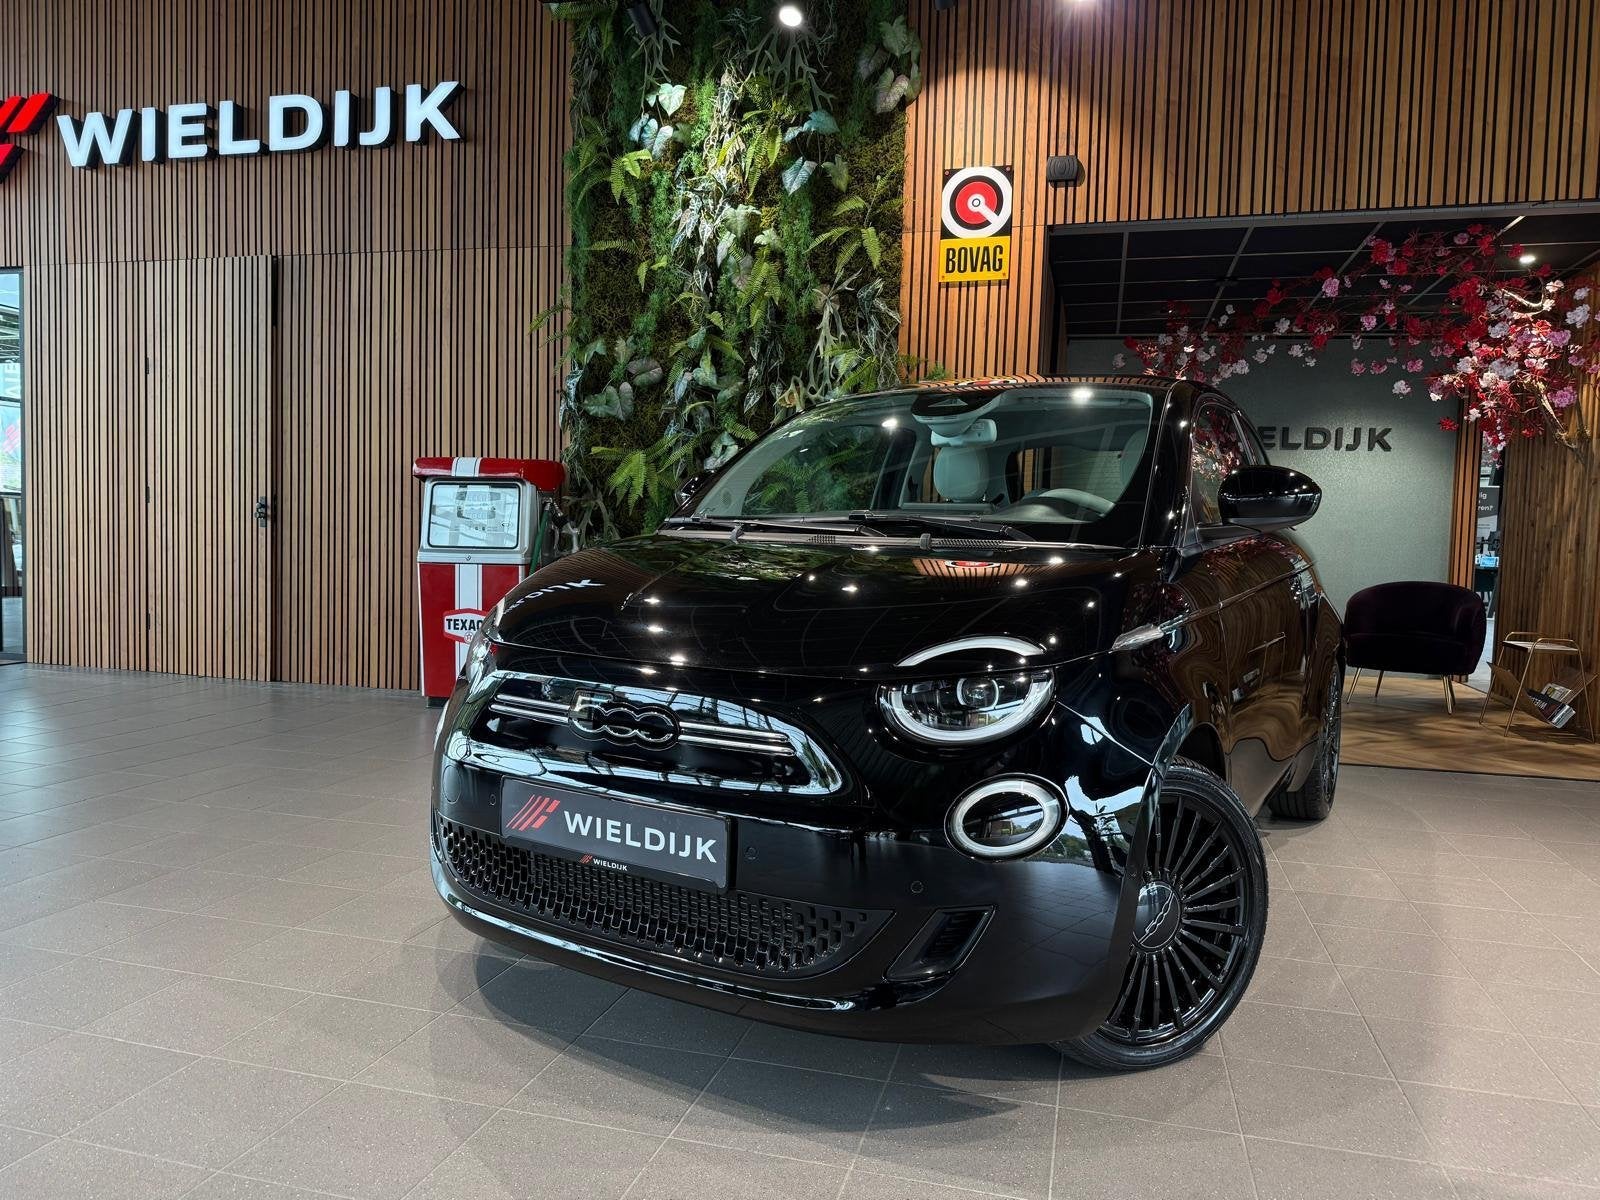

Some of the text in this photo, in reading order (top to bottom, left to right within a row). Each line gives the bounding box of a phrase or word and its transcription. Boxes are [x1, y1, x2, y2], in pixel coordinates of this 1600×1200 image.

[56, 81, 461, 168] WIELDIJK
[945, 245, 1004, 273] BOVAG
[1257, 426, 1393, 452] ELDIJK
[446, 618, 483, 631] TEXAC
[568, 688, 679, 751] 500
[563, 810, 717, 864] WIELDIJK
[593, 858, 628, 871] WIELDIJK
